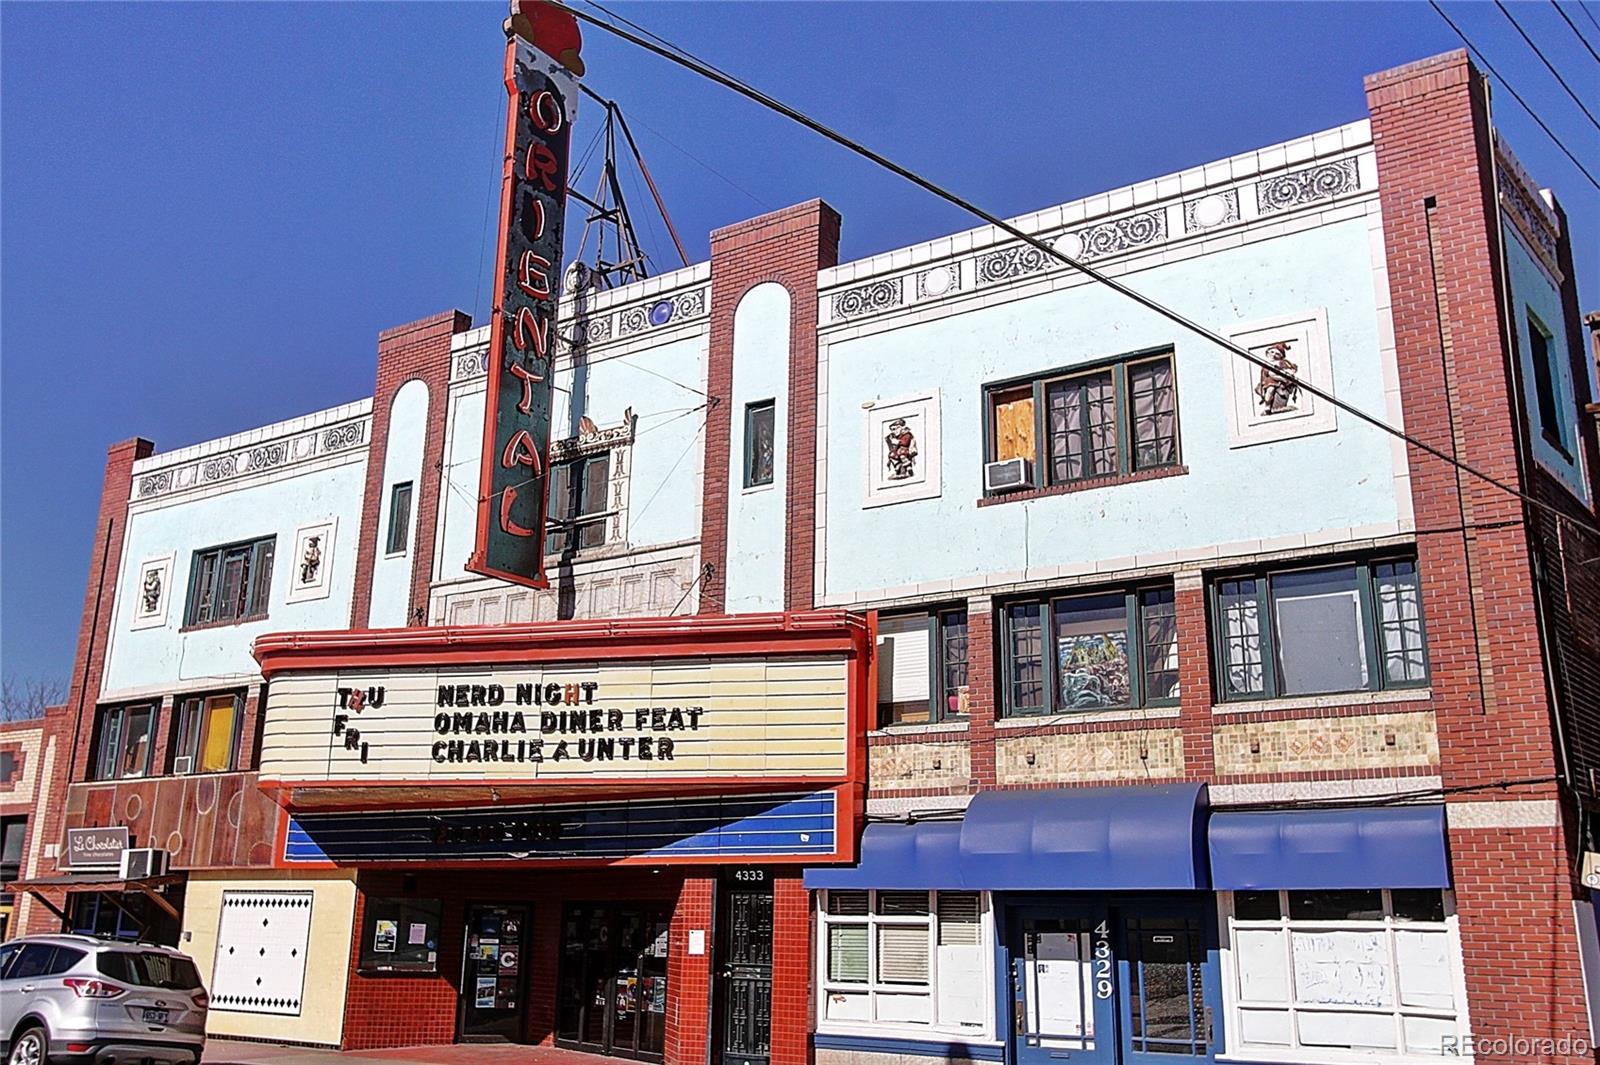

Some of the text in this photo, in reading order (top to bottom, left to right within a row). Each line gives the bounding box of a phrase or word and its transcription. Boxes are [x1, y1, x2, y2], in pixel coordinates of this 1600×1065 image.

[500, 90, 562, 537] ORIENTAL
[437, 682, 599, 708] NERD NIGHT
[434, 706, 704, 736] OMAHA DINER FEAT
[431, 739, 544, 764] CHARLIE
[735, 870, 764, 881] 4333
[1094, 919, 1114, 999] 4329
